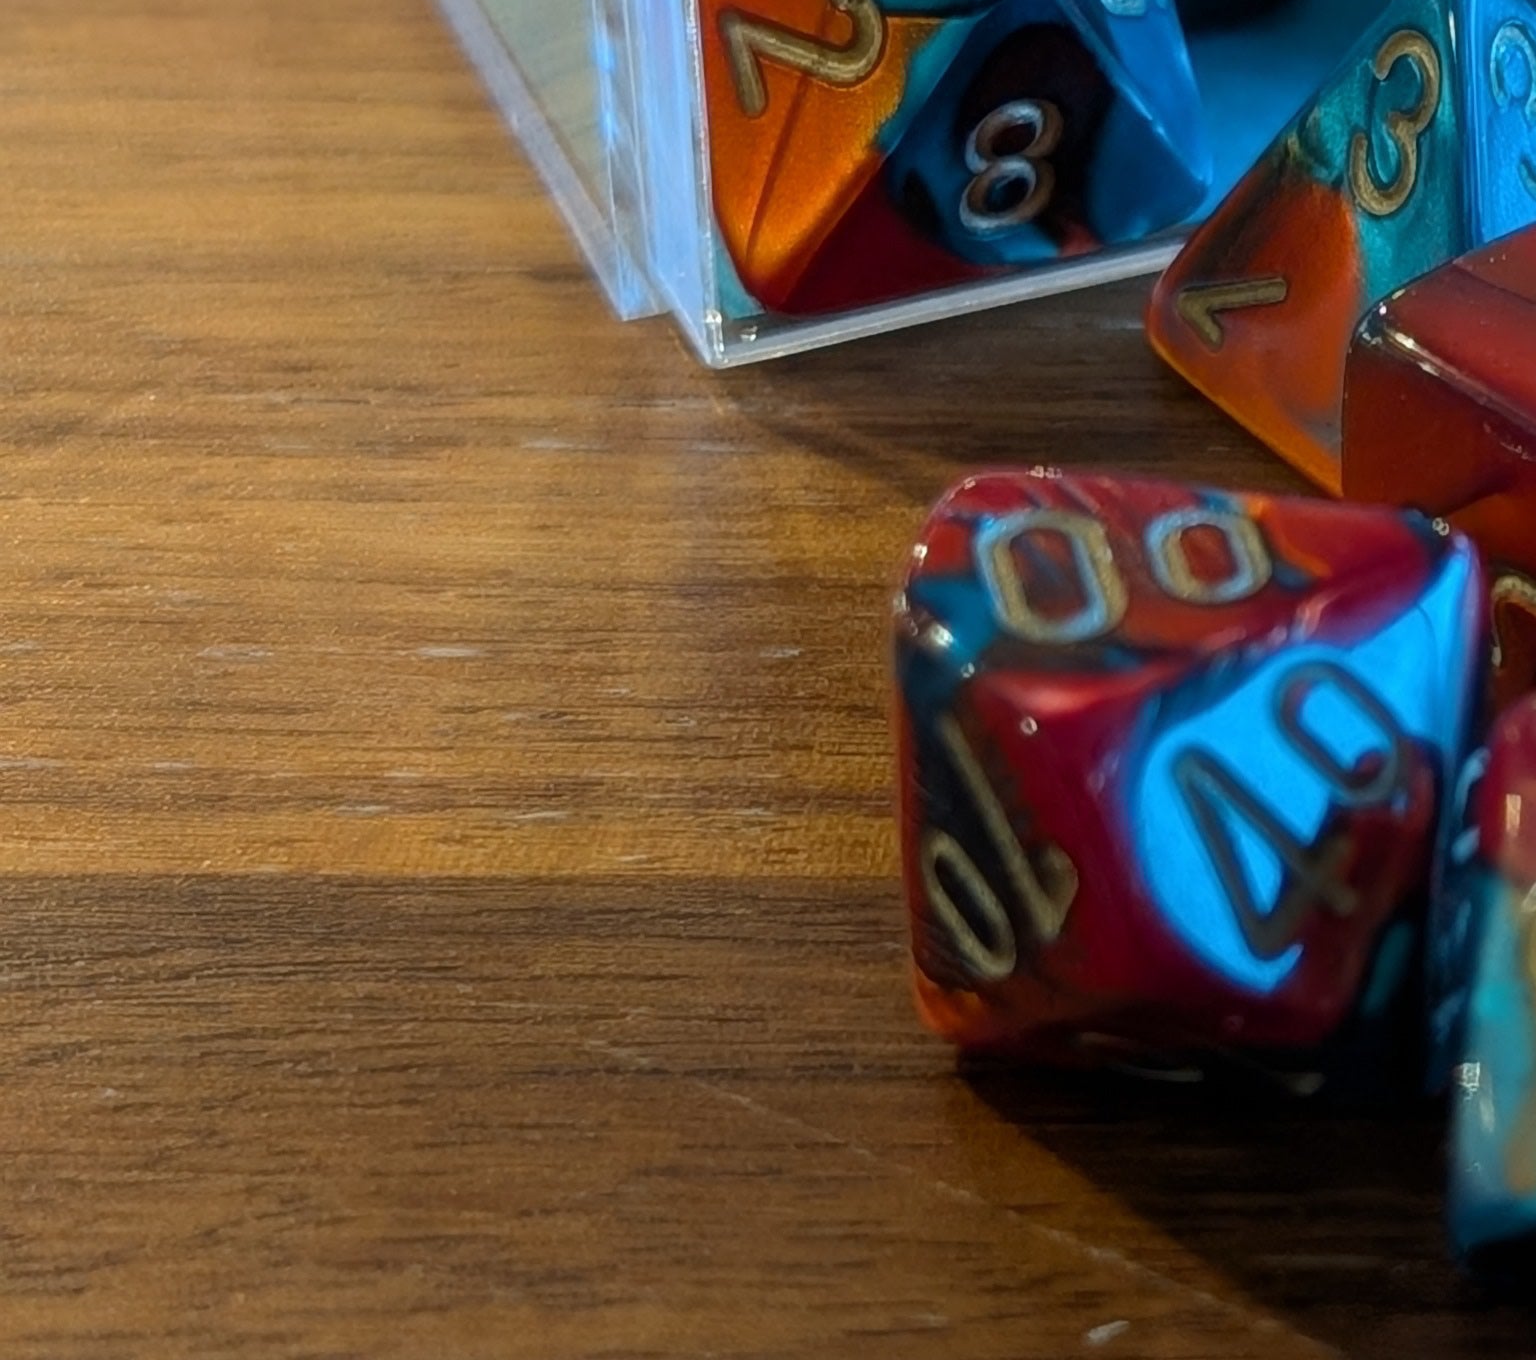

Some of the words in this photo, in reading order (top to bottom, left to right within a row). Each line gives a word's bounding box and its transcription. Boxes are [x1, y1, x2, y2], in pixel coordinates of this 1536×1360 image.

[958, 97, 1065, 233] 8
[1348, 28, 1444, 218] 3
[1176, 277, 1288, 346] 1
[923, 712, 1079, 980] 10
[1168, 658, 1414, 960] 40
